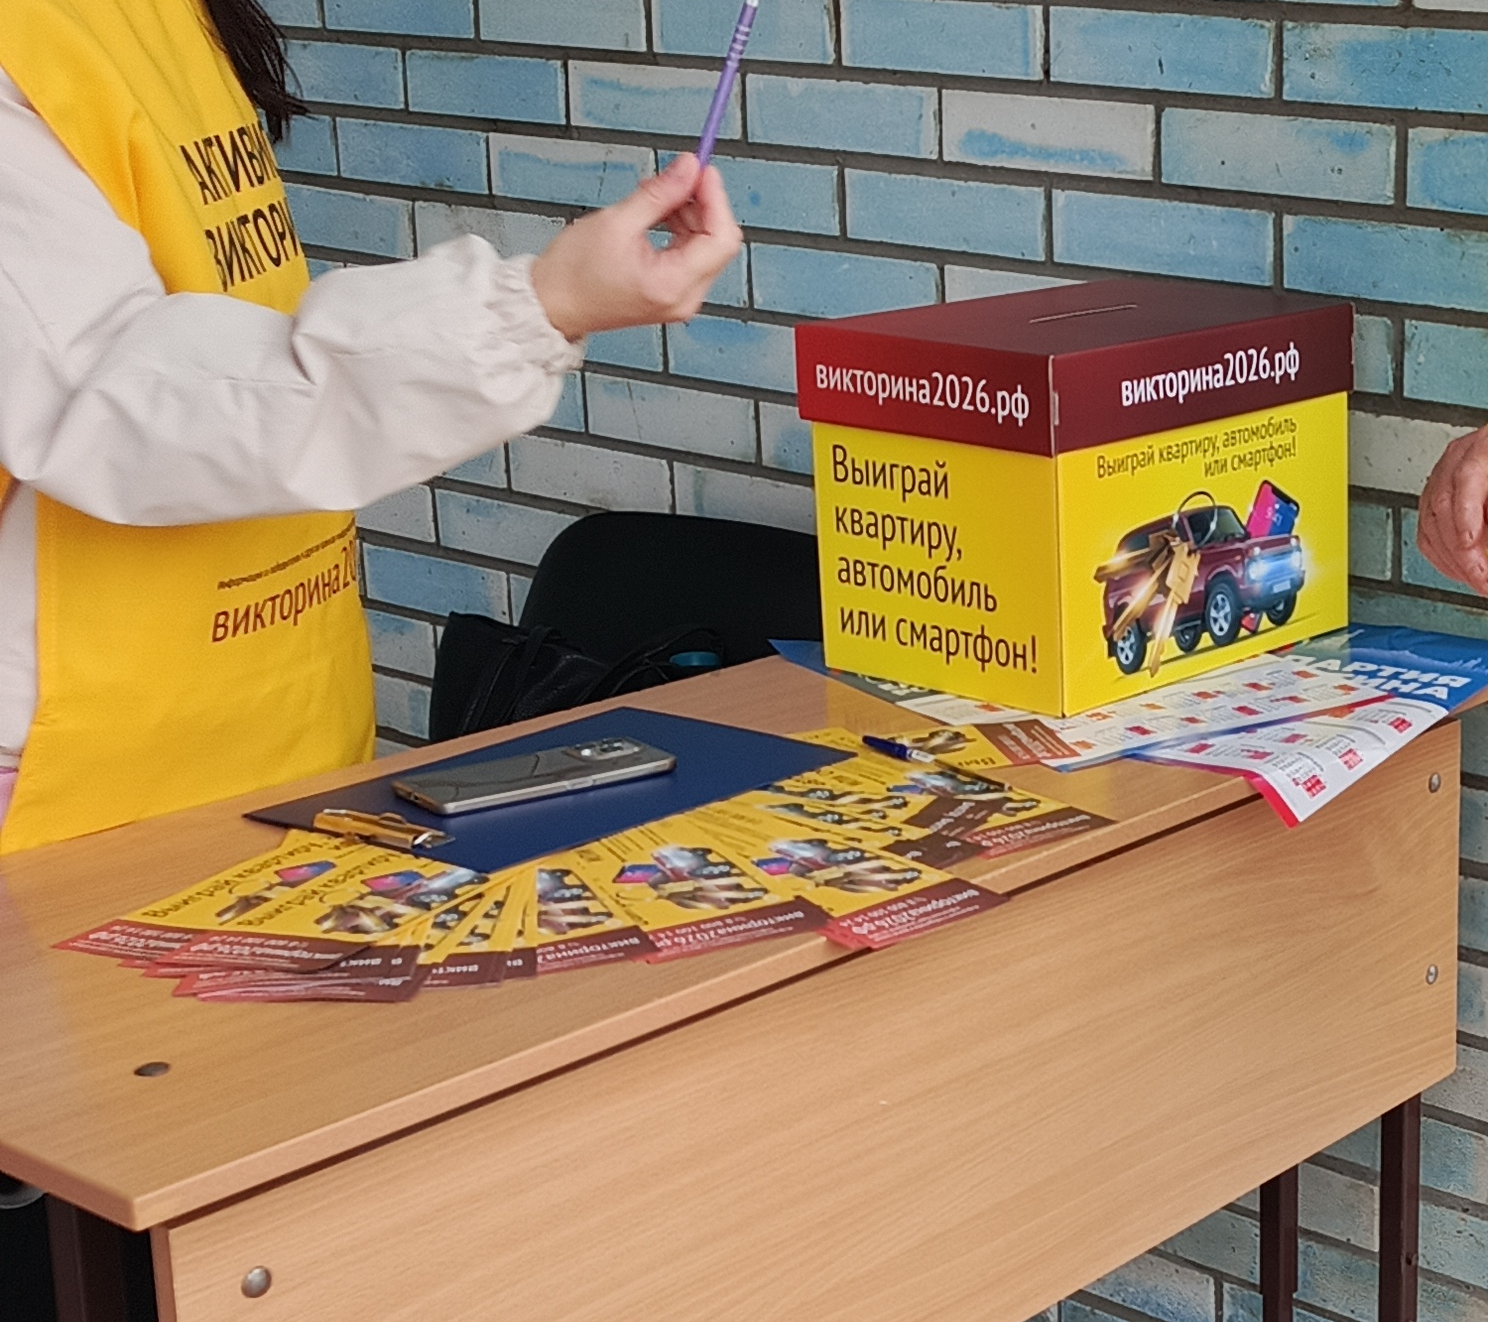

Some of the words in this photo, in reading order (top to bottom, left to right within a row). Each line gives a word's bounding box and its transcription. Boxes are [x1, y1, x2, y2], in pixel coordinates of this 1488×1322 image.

[815, 363, 1030, 427] викторина2026.рф
[1121, 341, 1300, 407] викторина2026.рф
[832, 444, 949, 503] Выиграй
[1096, 444, 1156, 479] Выиграй
[1158, 432, 1221, 465] квартиру,
[1222, 416, 1298, 449] автомобиль
[1204, 458, 1228, 478] или
[1230, 436, 1298, 474] смартфон!
[834, 505, 963, 562] квартиру,
[837, 556, 998, 613] автомобиль
[840, 606, 886, 642] или
[896, 616, 1038, 674] смартфон!
